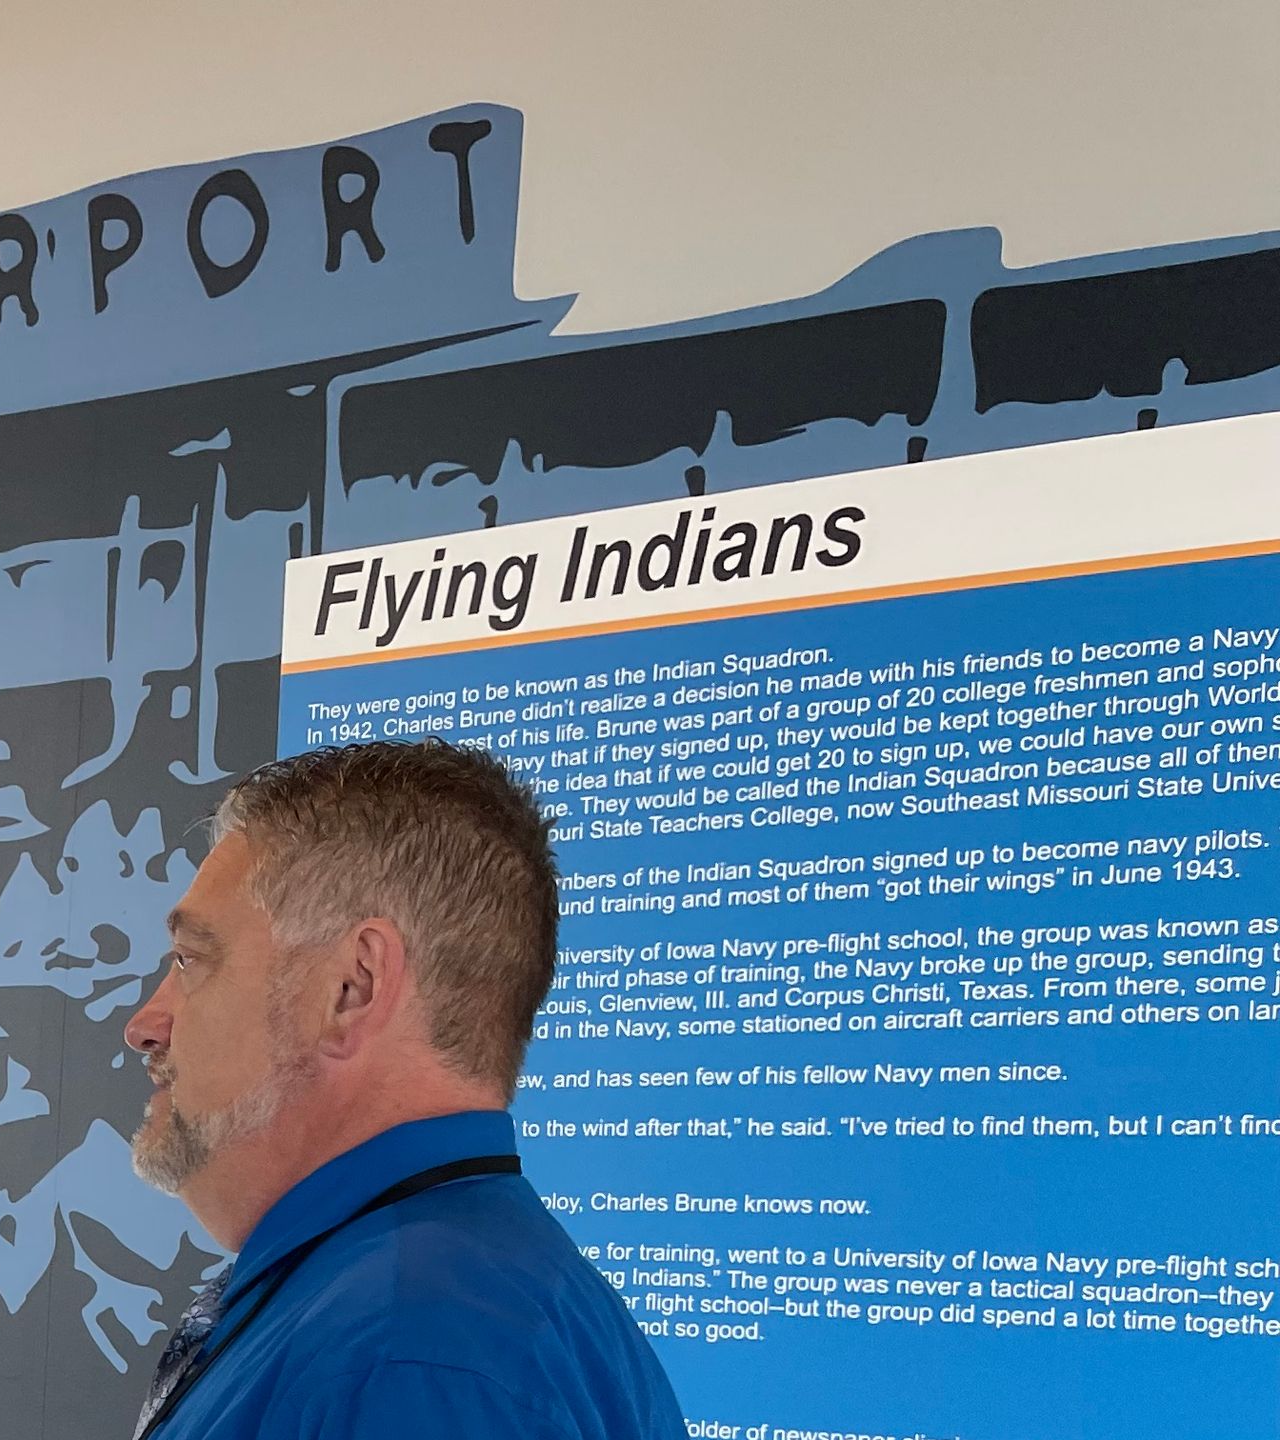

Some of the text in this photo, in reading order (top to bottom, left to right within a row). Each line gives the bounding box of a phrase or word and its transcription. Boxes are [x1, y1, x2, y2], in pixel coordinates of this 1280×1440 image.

[314, 506, 867, 647] Flying Indians
[306, 626, 1279, 745] In 1942, Charles Brune didn't realize a decision he made with his friends to become a Navy
[307, 647, 833, 721] They were going to be known as the Indian Squadron.
[673, 1322, 700, 1337] so
[704, 1321, 765, 1342] good.
